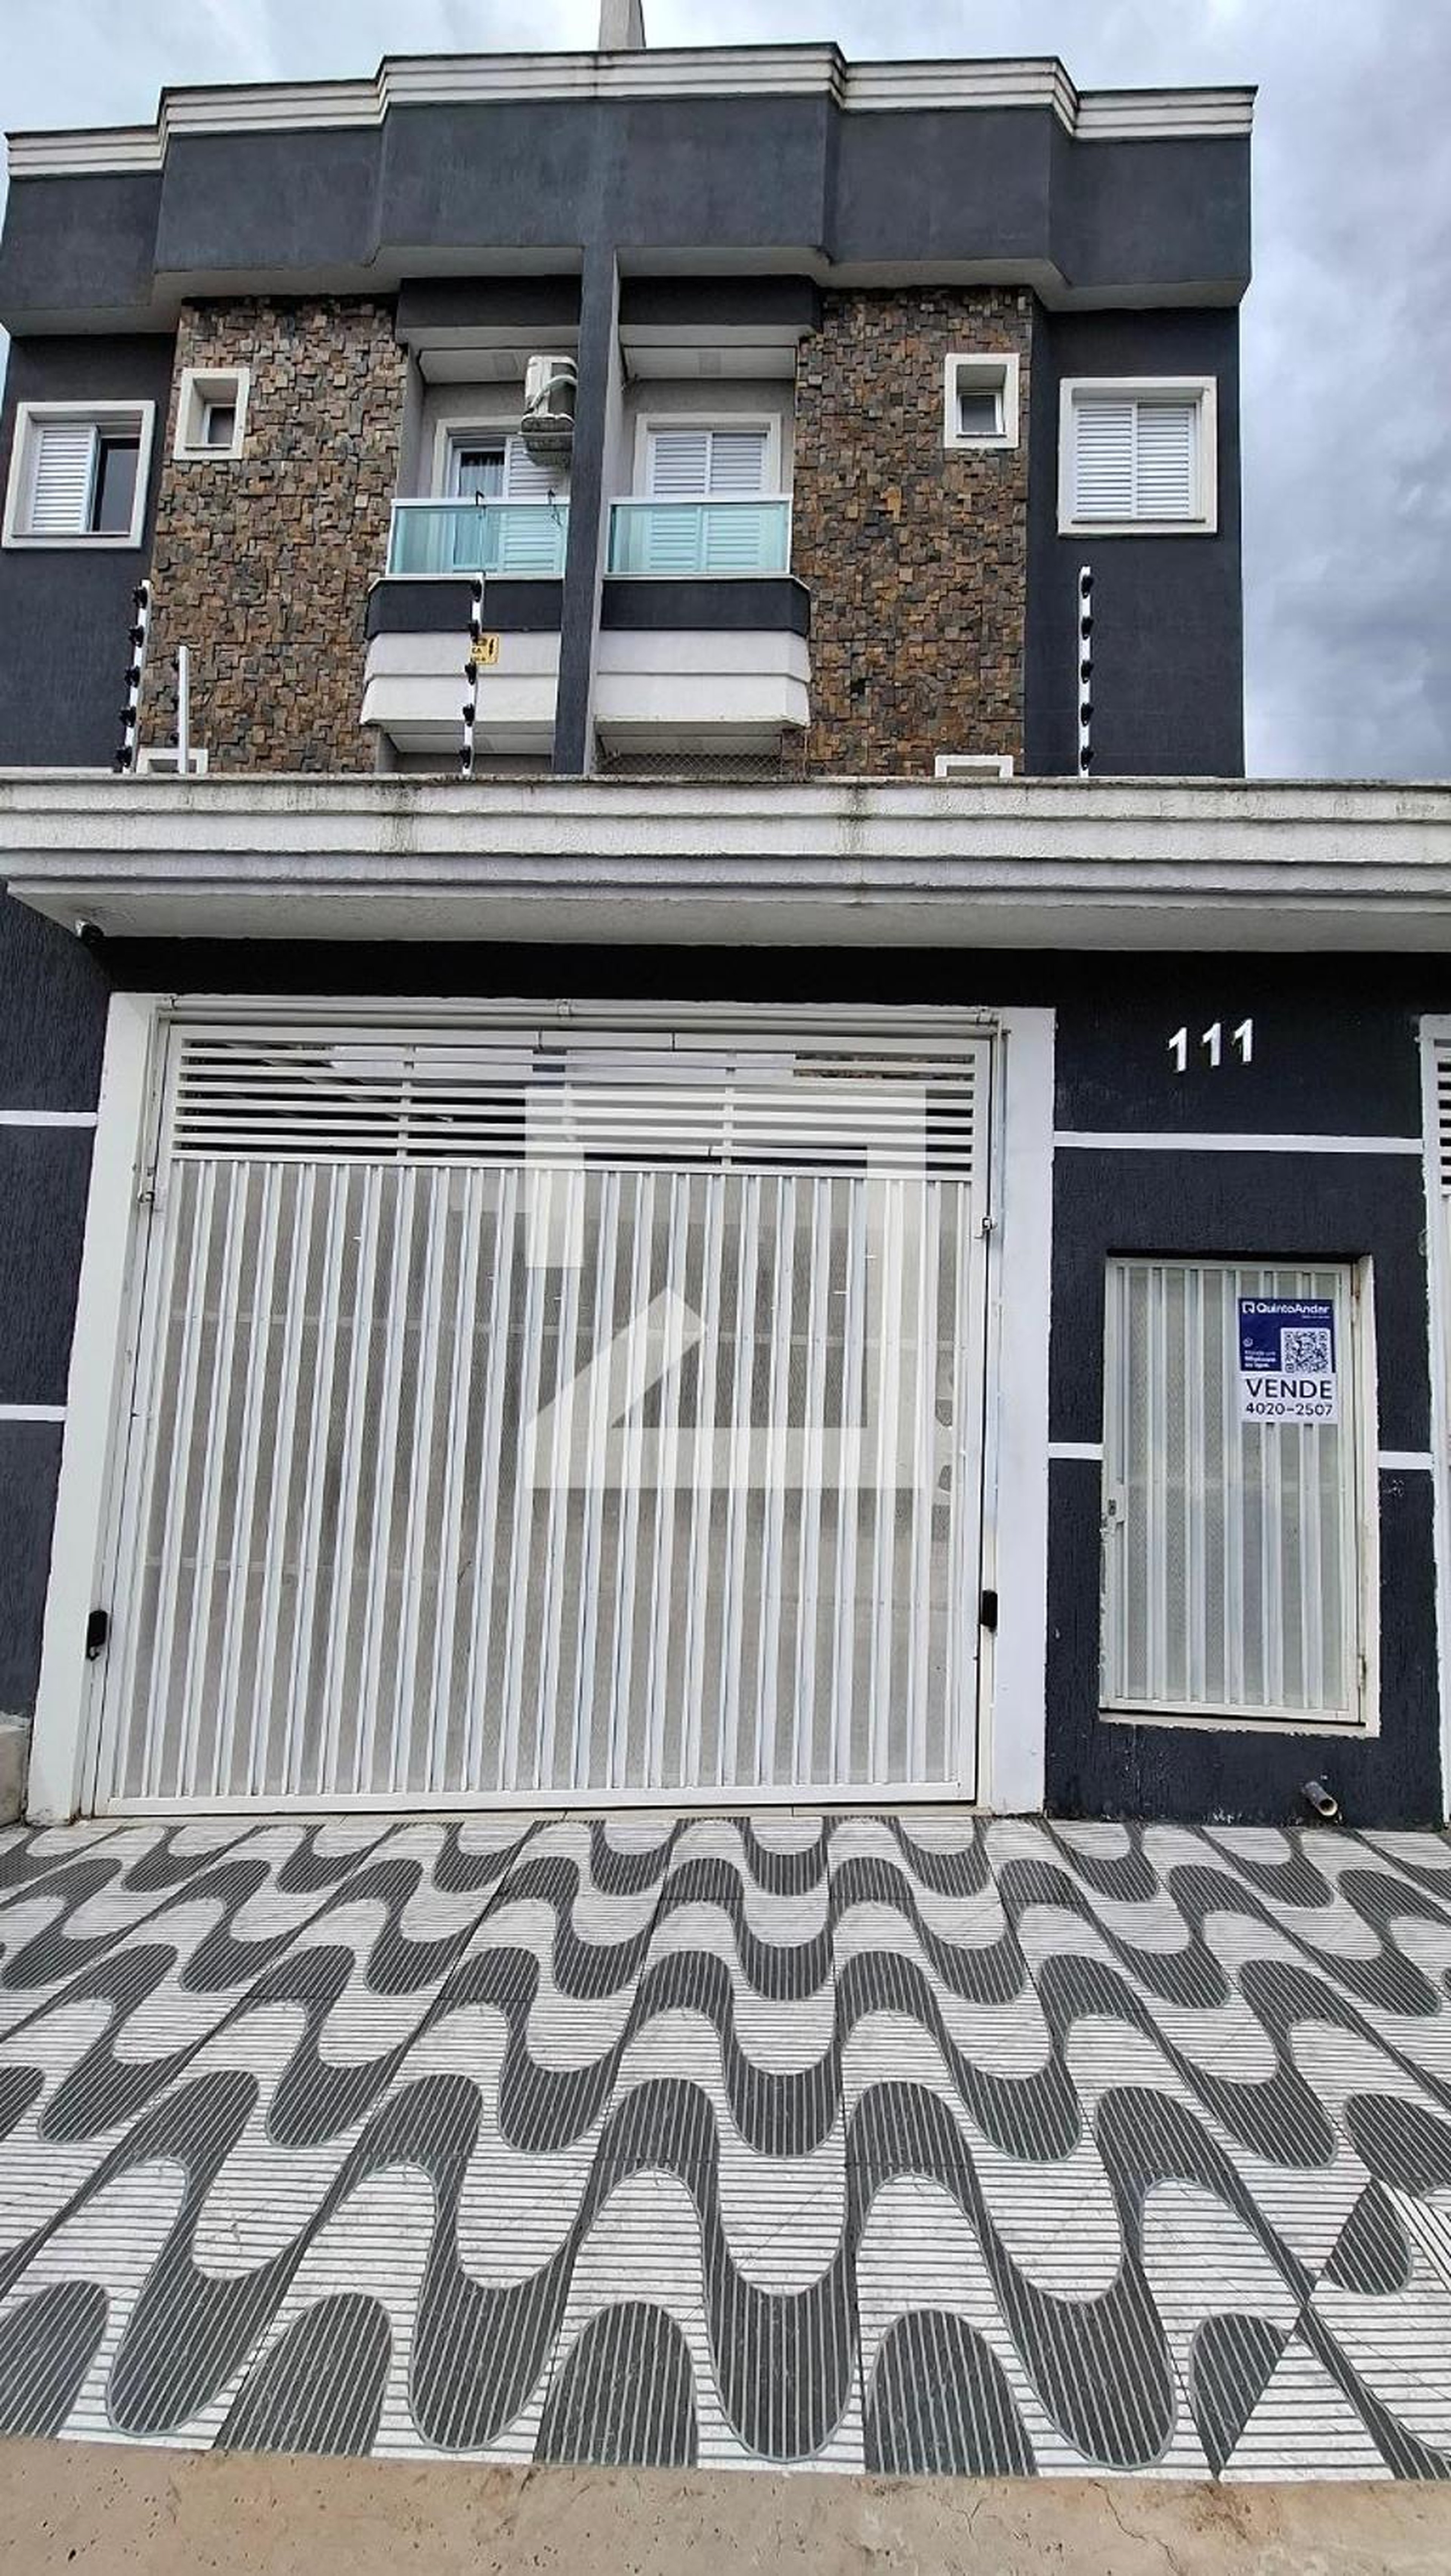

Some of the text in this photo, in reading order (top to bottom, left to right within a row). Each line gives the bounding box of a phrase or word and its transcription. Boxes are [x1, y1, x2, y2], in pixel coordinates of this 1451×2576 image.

[1167, 1018, 1253, 1072] 111
[1256, 1303, 1330, 1313] QuintoAndar
[1246, 1379, 1333, 1399] VENDE
[1246, 1402, 1333, 1416] 4020-2507
